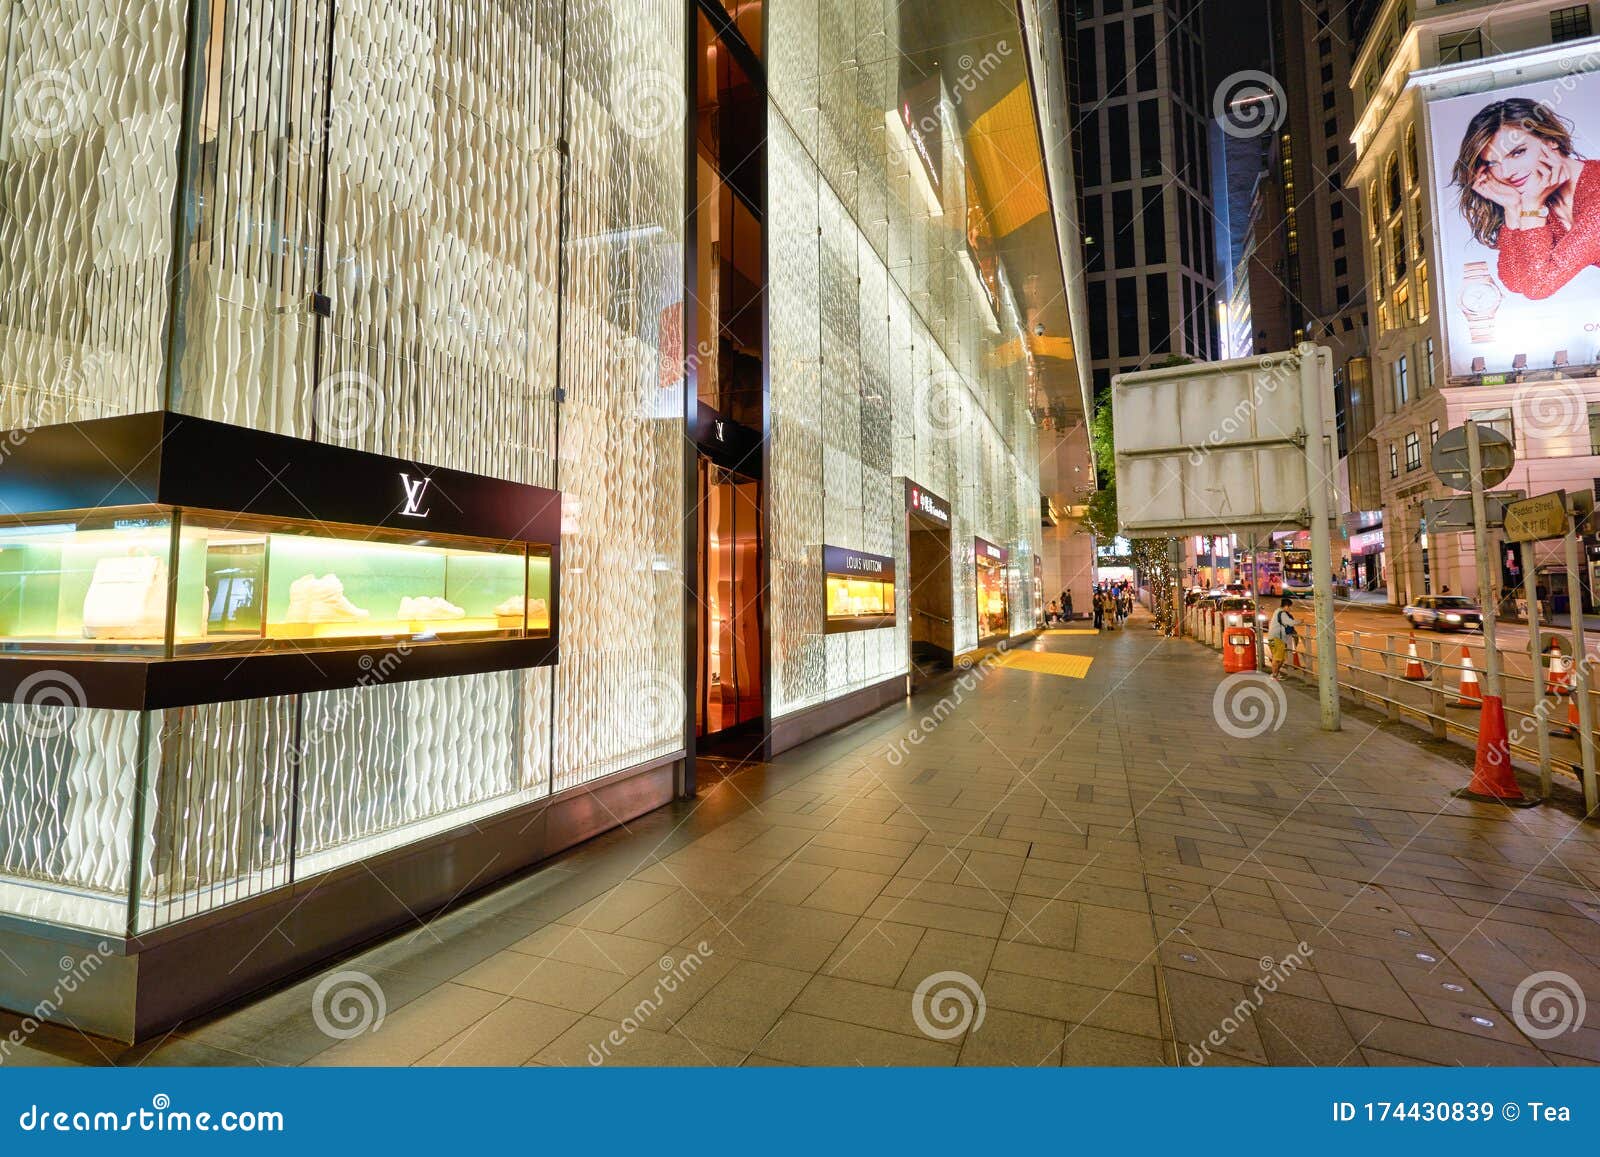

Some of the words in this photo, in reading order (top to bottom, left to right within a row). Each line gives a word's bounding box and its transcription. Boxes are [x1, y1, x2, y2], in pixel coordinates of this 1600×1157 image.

[398, 472, 431, 518] LV
[1512, 504, 1534, 517] Pedder
[1535, 499, 1554, 513] Street
[846, 555, 861, 570] LOUIS
[862, 558, 882, 573] VUITTON
